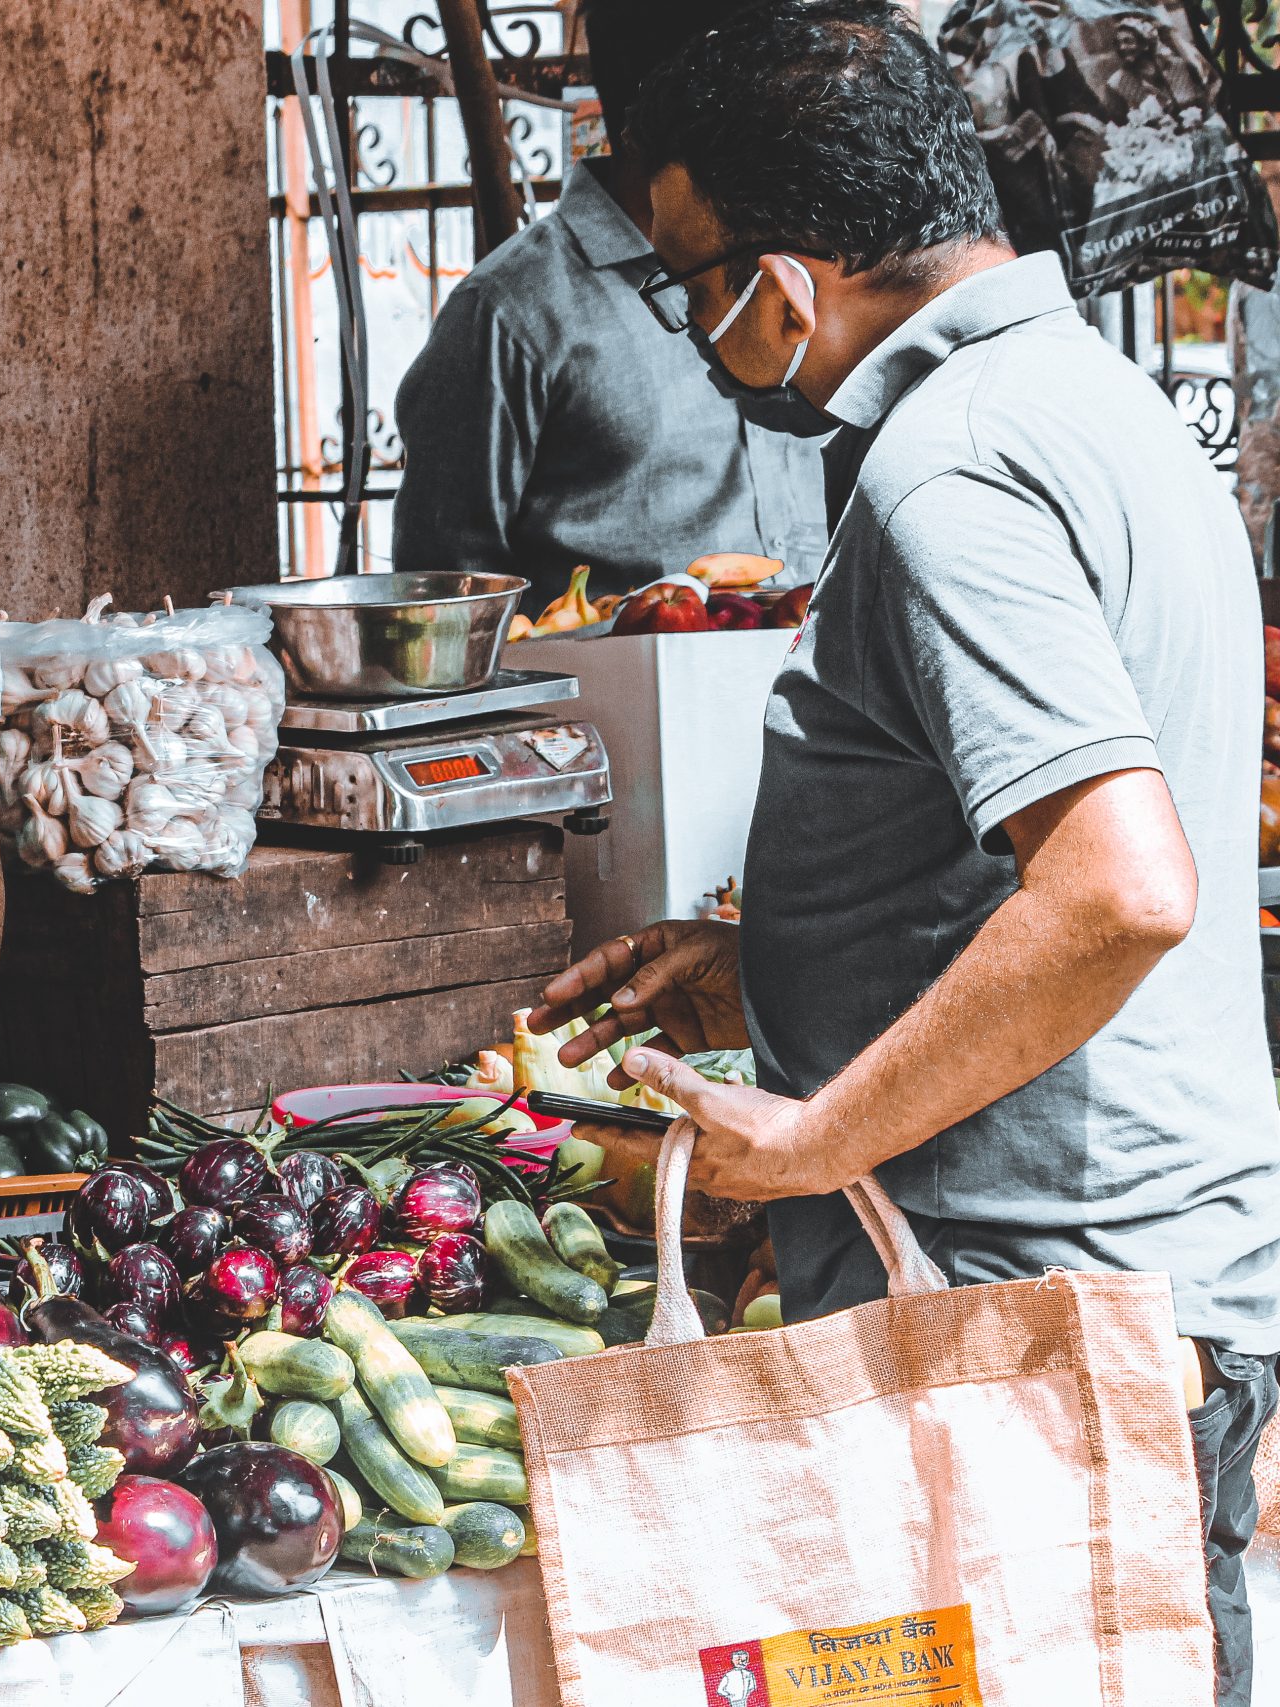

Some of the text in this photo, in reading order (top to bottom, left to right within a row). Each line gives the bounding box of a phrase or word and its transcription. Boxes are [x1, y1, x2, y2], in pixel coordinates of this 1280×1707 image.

[808, 1616, 937, 1655] विजया बैंक
[784, 1643, 955, 1689] VIJAYA BANK
